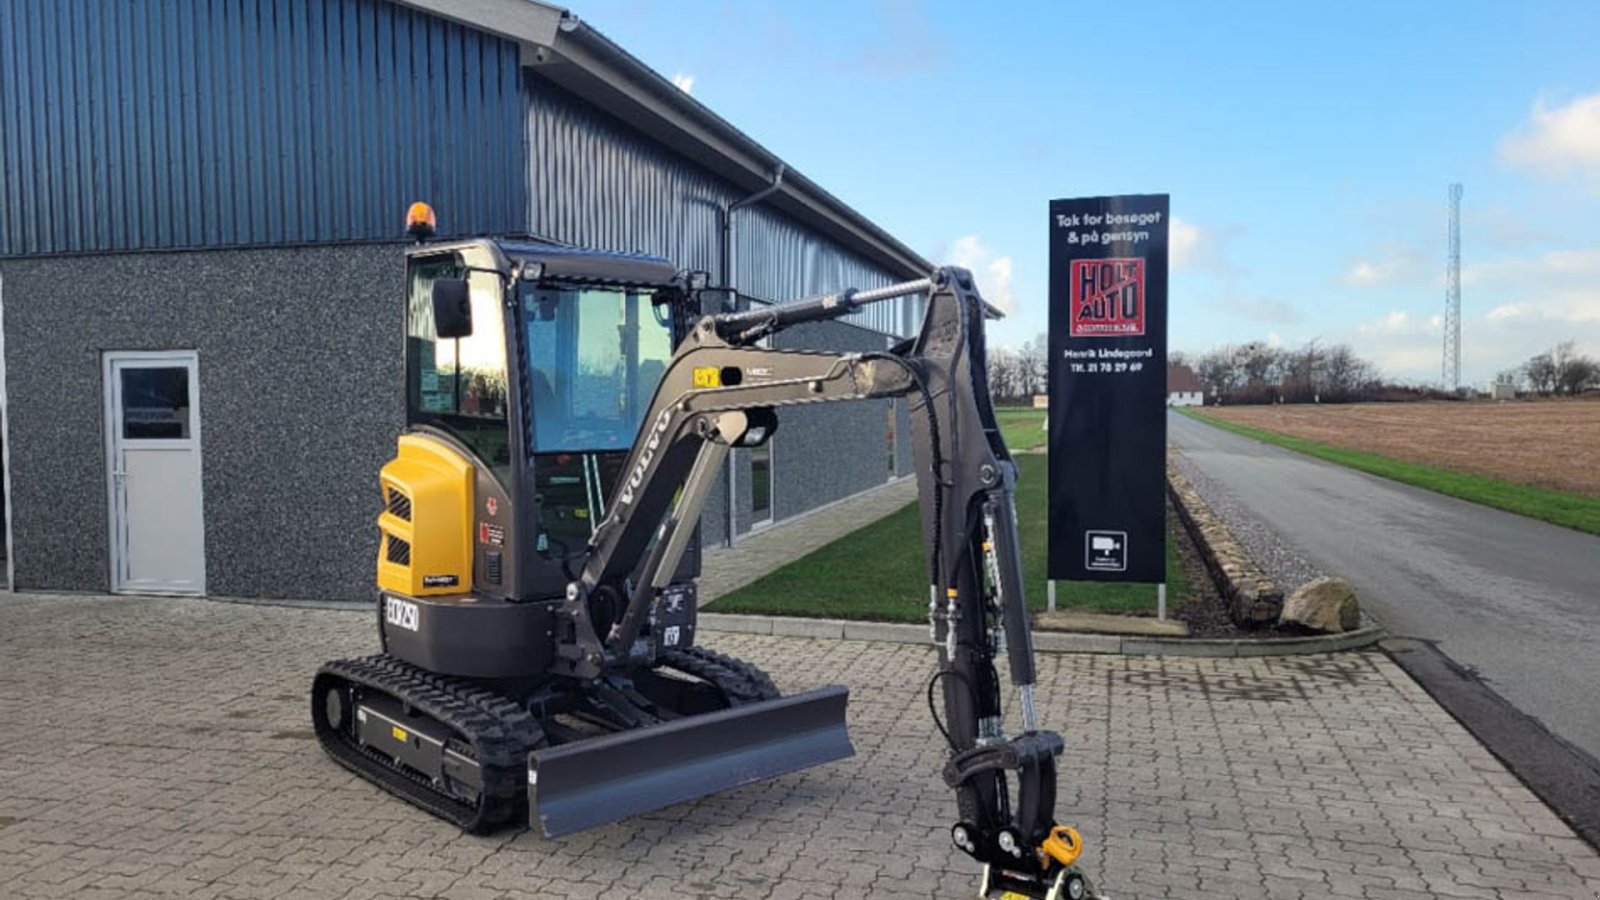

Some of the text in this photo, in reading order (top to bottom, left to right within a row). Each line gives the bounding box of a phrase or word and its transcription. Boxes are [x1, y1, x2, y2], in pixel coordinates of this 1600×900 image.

[1056, 211, 1161, 227] Tak for besøget
[1067, 230, 1149, 246] & på gensyn
[1077, 280, 1139, 321] AUTO
[1080, 263, 1139, 302] HOLT
[621, 411, 671, 505] VOLVO
